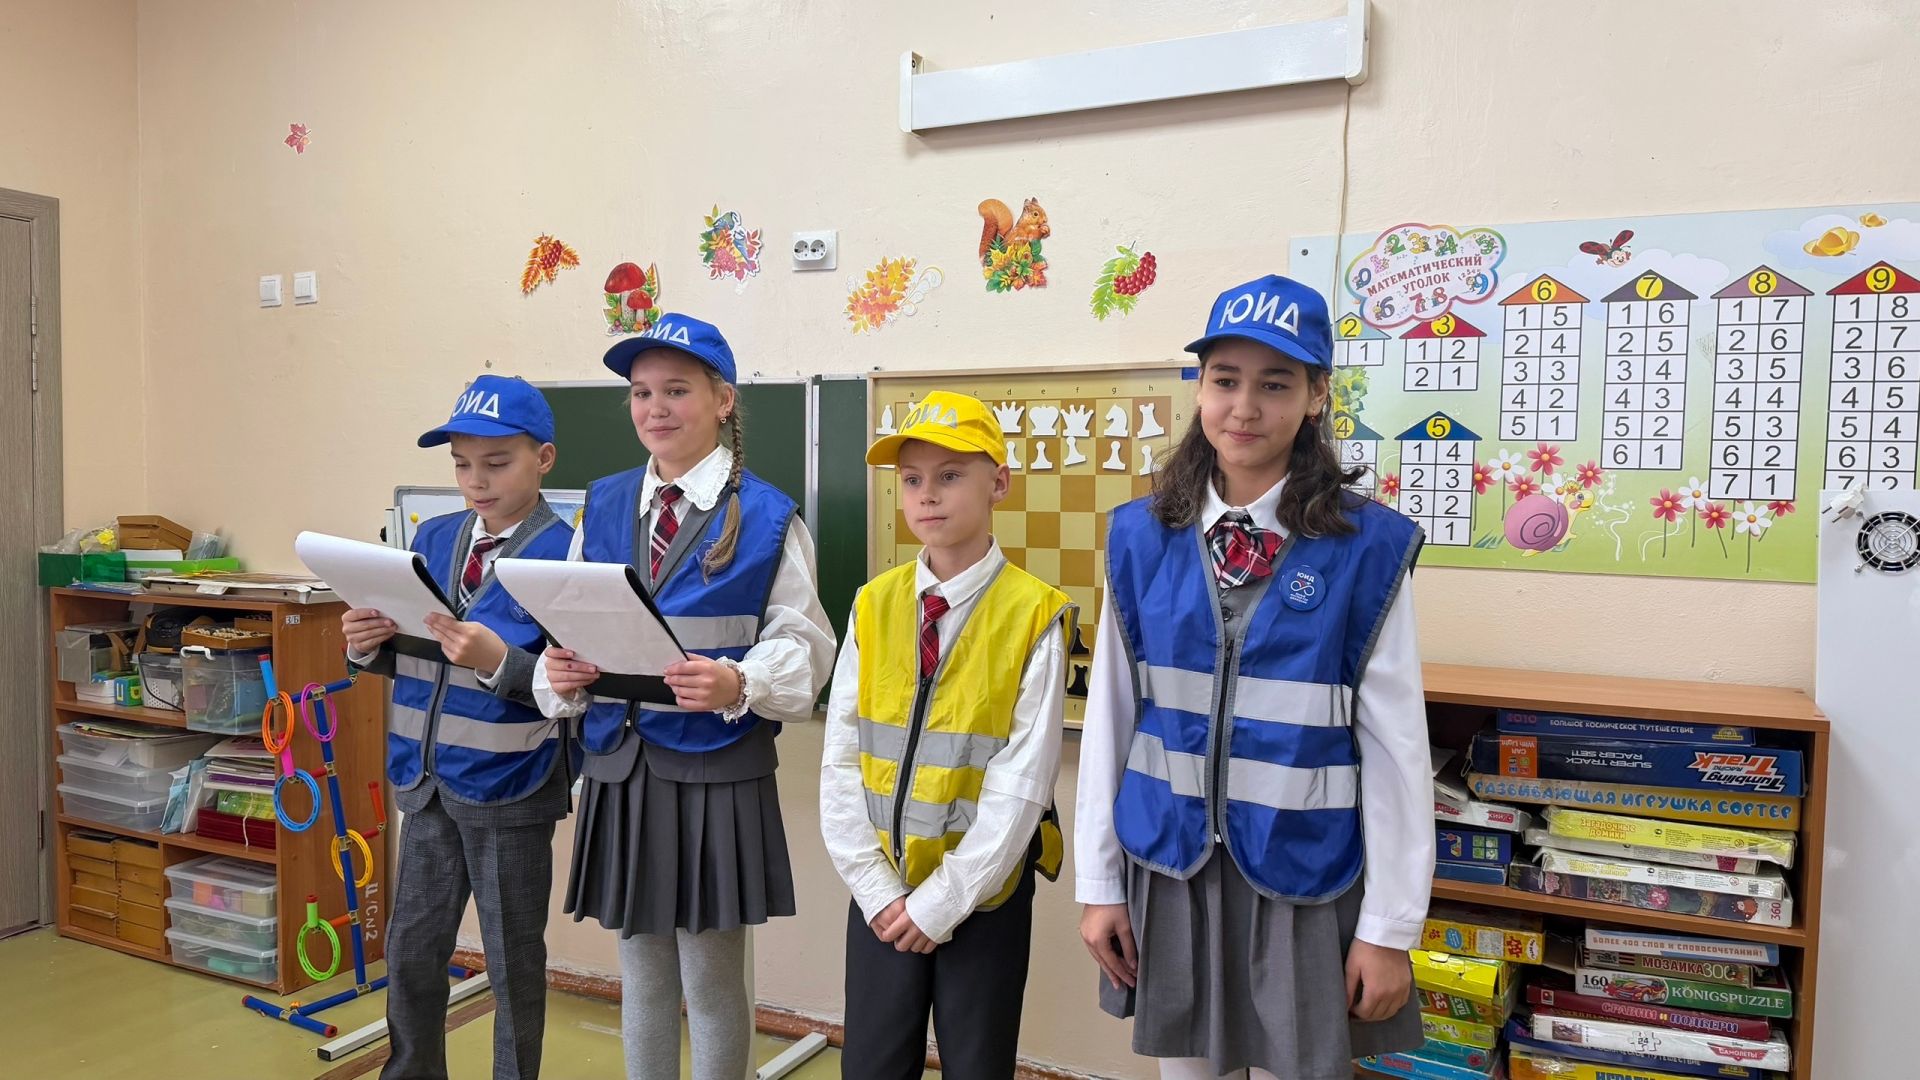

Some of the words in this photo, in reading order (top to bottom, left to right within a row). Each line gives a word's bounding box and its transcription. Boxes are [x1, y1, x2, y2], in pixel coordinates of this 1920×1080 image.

[1386, 234, 1406, 256] 2
[1407, 232, 1426, 254] 3
[1434, 234, 1458, 257] 4
[1475, 233, 1496, 256] 5
[1357, 267, 1372, 287] 0
[1367, 254, 1482, 296] МАТЕМАТИЧЕСКИЙ
[1402, 272, 1450, 294] УГОЛОК
[1474, 273, 1489, 295] 9
[1754, 271, 1771, 294] 8
[1872, 268, 1890, 291] 9
[1432, 286, 1448, 306] 8
[1537, 280, 1552, 302] 6
[1643, 276, 1657, 298] 7
[1380, 296, 1395, 318] 6
[1409, 292, 1426, 314] 7
[1621, 303, 1632, 325] 1
[1658, 302, 1674, 324] 6
[1732, 300, 1744, 322] 1
[1772, 298, 1790, 321] 7
[1849, 296, 1861, 319] 1
[1890, 295, 1909, 318] 8
[1219, 292, 1299, 337] ЮИД
[1436, 314, 1450, 336] 3
[1518, 306, 1528, 328] 1
[1552, 305, 1568, 327] 5
[641, 322, 690, 346] ИД
[1344, 318, 1358, 338] 2
[1844, 326, 1863, 350] 2
[1890, 326, 1908, 348] 7
[1418, 340, 1428, 360] 1
[1450, 339, 1466, 360] 2
[1514, 334, 1530, 355] 2
[1550, 333, 1566, 354] 4
[1617, 331, 1634, 353] 2
[1657, 330, 1674, 352] 5
[1728, 329, 1745, 351] 2
[1770, 328, 1788, 350] 6
[1360, 342, 1368, 362] 1
[1414, 366, 1430, 387] 2
[1452, 366, 1461, 386] 1
[1513, 361, 1528, 382] 3
[1550, 360, 1566, 381] 3
[1616, 360, 1632, 381] 3
[1654, 358, 1672, 381] 4
[1727, 358, 1744, 380] 3
[1769, 357, 1786, 380] 5
[1843, 356, 1861, 379] 3
[1887, 356, 1906, 378] 6
[1007, 388, 1012, 396] d
[1510, 388, 1527, 409] 4
[1548, 388, 1564, 409] 2
[1614, 388, 1631, 409] 4
[1654, 387, 1670, 409] 3
[1724, 386, 1742, 408] 4
[1766, 386, 1784, 408] 4
[1840, 386, 1859, 409] 4
[1886, 386, 1904, 409] 5
[1335, 418, 1350, 436] 4
[1431, 417, 1446, 437] 5
[1510, 416, 1526, 436] 5
[1550, 415, 1560, 436] 1
[1614, 416, 1630, 437] 5
[1652, 415, 1670, 437] 2
[1724, 416, 1741, 437] 5
[1766, 416, 1783, 438] 3
[1840, 416, 1858, 438] 5
[1883, 416, 1902, 438] 4
[1350, 441, 1364, 462] 3
[1412, 442, 1422, 462] 1
[1446, 442, 1461, 462] 4
[1613, 444, 1628, 465] 6
[1653, 444, 1664, 466] 1
[1722, 444, 1740, 466] 6
[1764, 445, 1782, 467] 2
[1838, 446, 1856, 468] 6
[1882, 446, 1900, 469] 3
[1410, 468, 1424, 488] 2
[1446, 468, 1460, 488] 3
[1722, 473, 1739, 495] 7
[1765, 473, 1776, 496] 1
[1838, 475, 1855, 490] 7
[1409, 494, 1423, 514] 3
[1444, 495, 1459, 515] 2
[1445, 521, 1454, 541] 1
[1550, 720, 1583, 728] БОЛЬШОЕ
[1585, 721, 1637, 730] КОСМИЧЕСКОЕ
[1640, 724, 1694, 734] ПУТЕШЕСТВИЕ
[1566, 757, 1608, 766] TRACK
[1571, 750, 1598, 758] SET!
[1599, 751, 1643, 760] RACER
[1610, 760, 1652, 769] SUPER
[1706, 771, 1784, 791] Tumbling
[1474, 781, 1617, 805] РАЗВИВАЮЩАЯ
[1621, 793, 1712, 813] ИГРУШКА
[1717, 800, 1793, 819] СОРТЕР
[1770, 903, 1781, 920] 360
[1593, 936, 1620, 945] БОЛЕЕ
[1642, 940, 1664, 949] СЛОВ
[1677, 943, 1762, 957] СЛОВОСОЧЕТАНИЙ!
[1642, 956, 1704, 974] МОЗАИКА
[1583, 974, 1608, 987] 160
[1672, 984, 1784, 1009] KÖNIGSPUZZLE
[1602, 1002, 1657, 1020] СРАВНИ
[1670, 1014, 1738, 1033] ПОДБЕРИ
